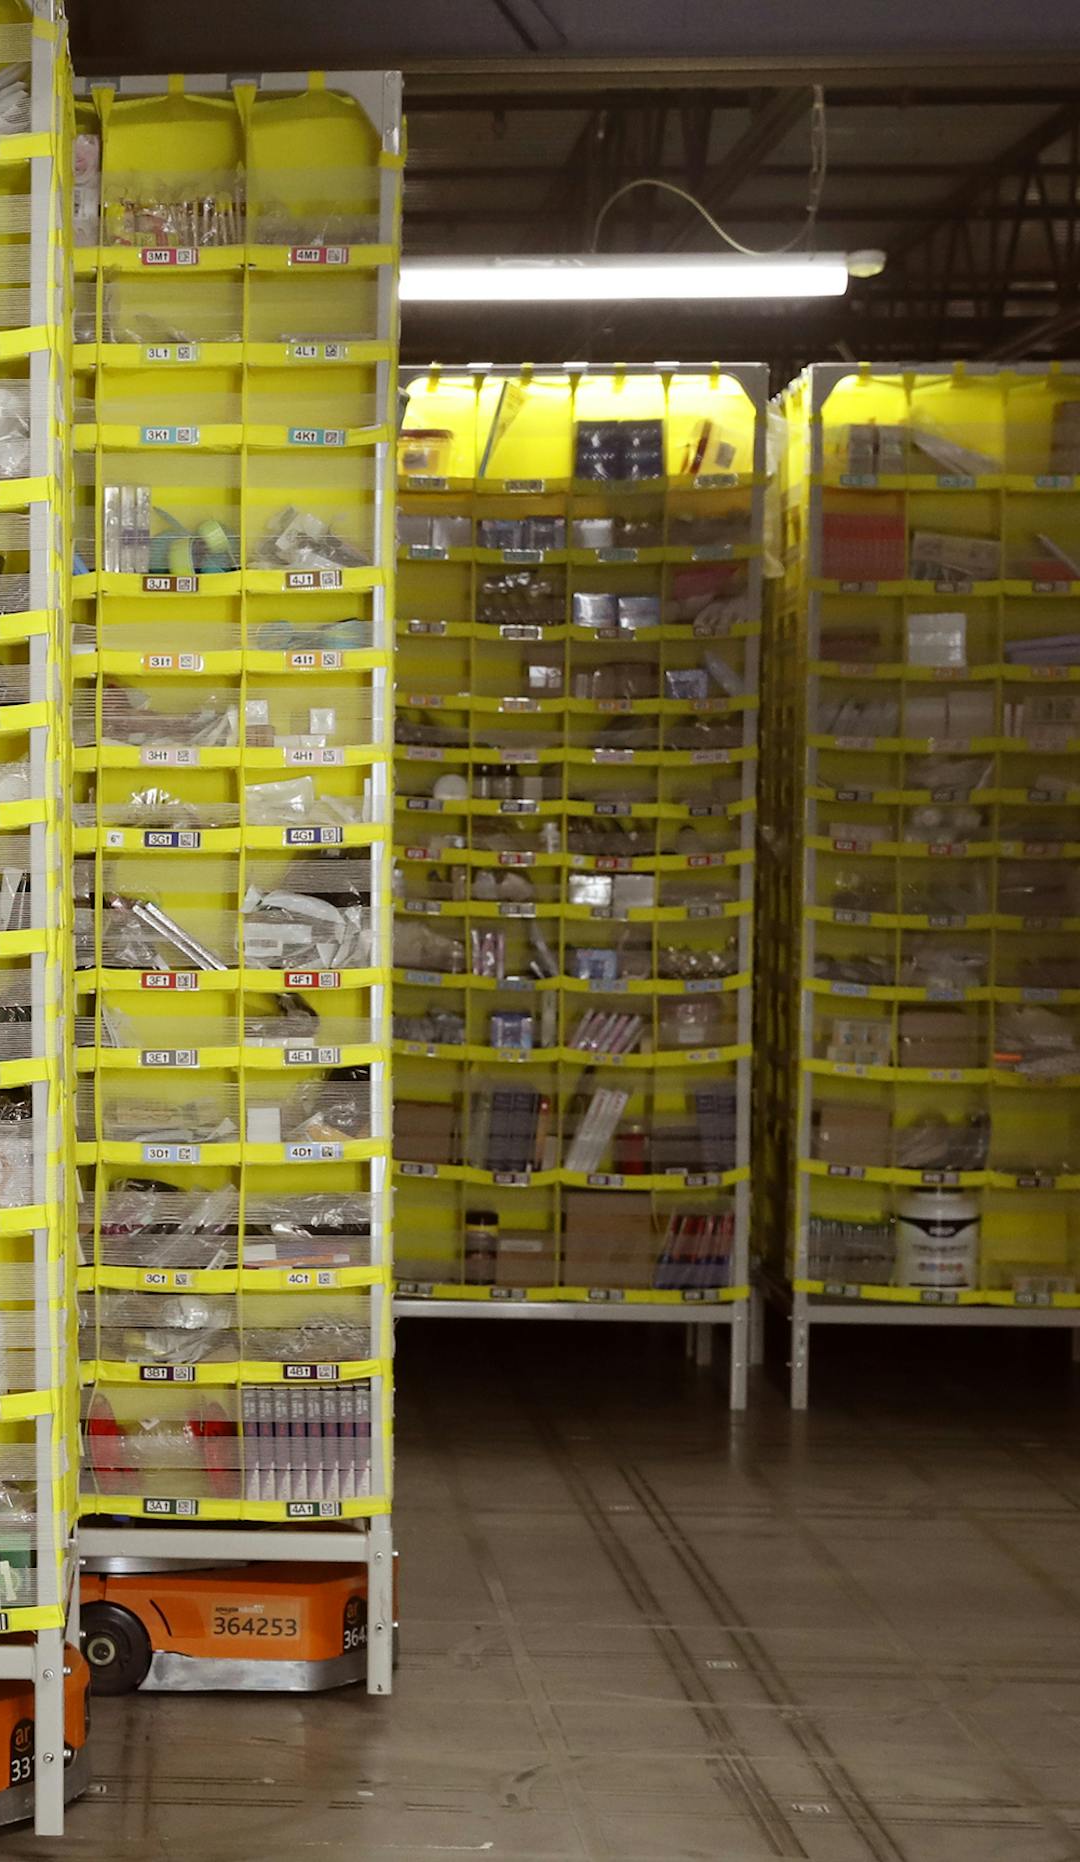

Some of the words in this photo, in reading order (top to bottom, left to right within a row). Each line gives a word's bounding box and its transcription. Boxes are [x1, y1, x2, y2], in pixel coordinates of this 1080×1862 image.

[147, 253, 163, 262] 3M
[297, 251, 313, 261] 4M
[149, 348, 161, 358] 3L
[295, 347, 309, 356] 4L
[147, 431, 162, 440] 3K
[295, 432, 310, 441] 4K
[148, 580, 161, 589] 3J
[292, 575, 306, 585] 4J
[151, 657, 164, 666] 3I
[294, 656, 306, 665] 4I
[148, 752, 163, 761] 3H
[293, 752, 307, 761] 4H
[150, 835, 166, 845] 3G
[292, 831, 307, 841] 4G
[150, 976, 161, 986] 3F
[292, 976, 304, 985] 4F
[148, 1053, 161, 1063] 3E
[292, 1051, 304, 1062] 4E
[150, 1149, 164, 1159] 3D
[292, 1148, 306, 1157] 4D
[146, 1274, 160, 1284] 3C
[289, 1274, 303, 1284] 4C
[144, 1368, 159, 1378] 3B
[289, 1367, 304, 1376] 4B
[147, 1502, 163, 1511] 3A
[291, 1505, 306, 1514] 4A
[213, 1617, 297, 1637] 364253
[344, 1625, 368, 1649] 364
[11, 1755, 35, 1782] 33
